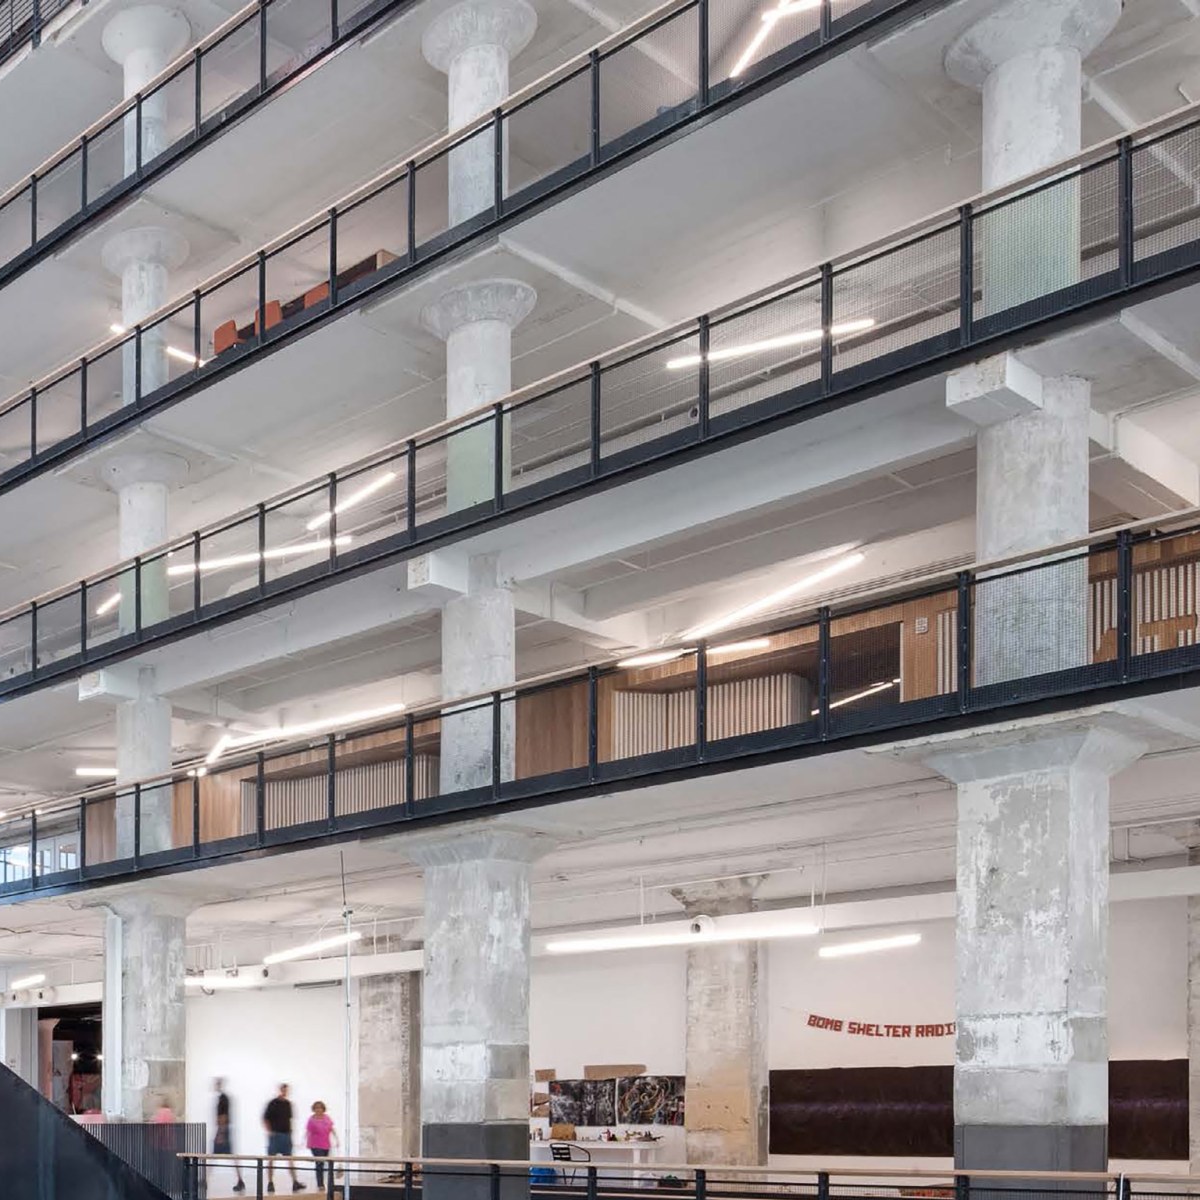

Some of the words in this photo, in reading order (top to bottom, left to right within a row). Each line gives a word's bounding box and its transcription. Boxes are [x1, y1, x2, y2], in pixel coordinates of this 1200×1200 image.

[806, 1014, 844, 1032] BOMB
[847, 1021, 912, 1038] SHELTER
[914, 1020, 956, 1038] RADI
